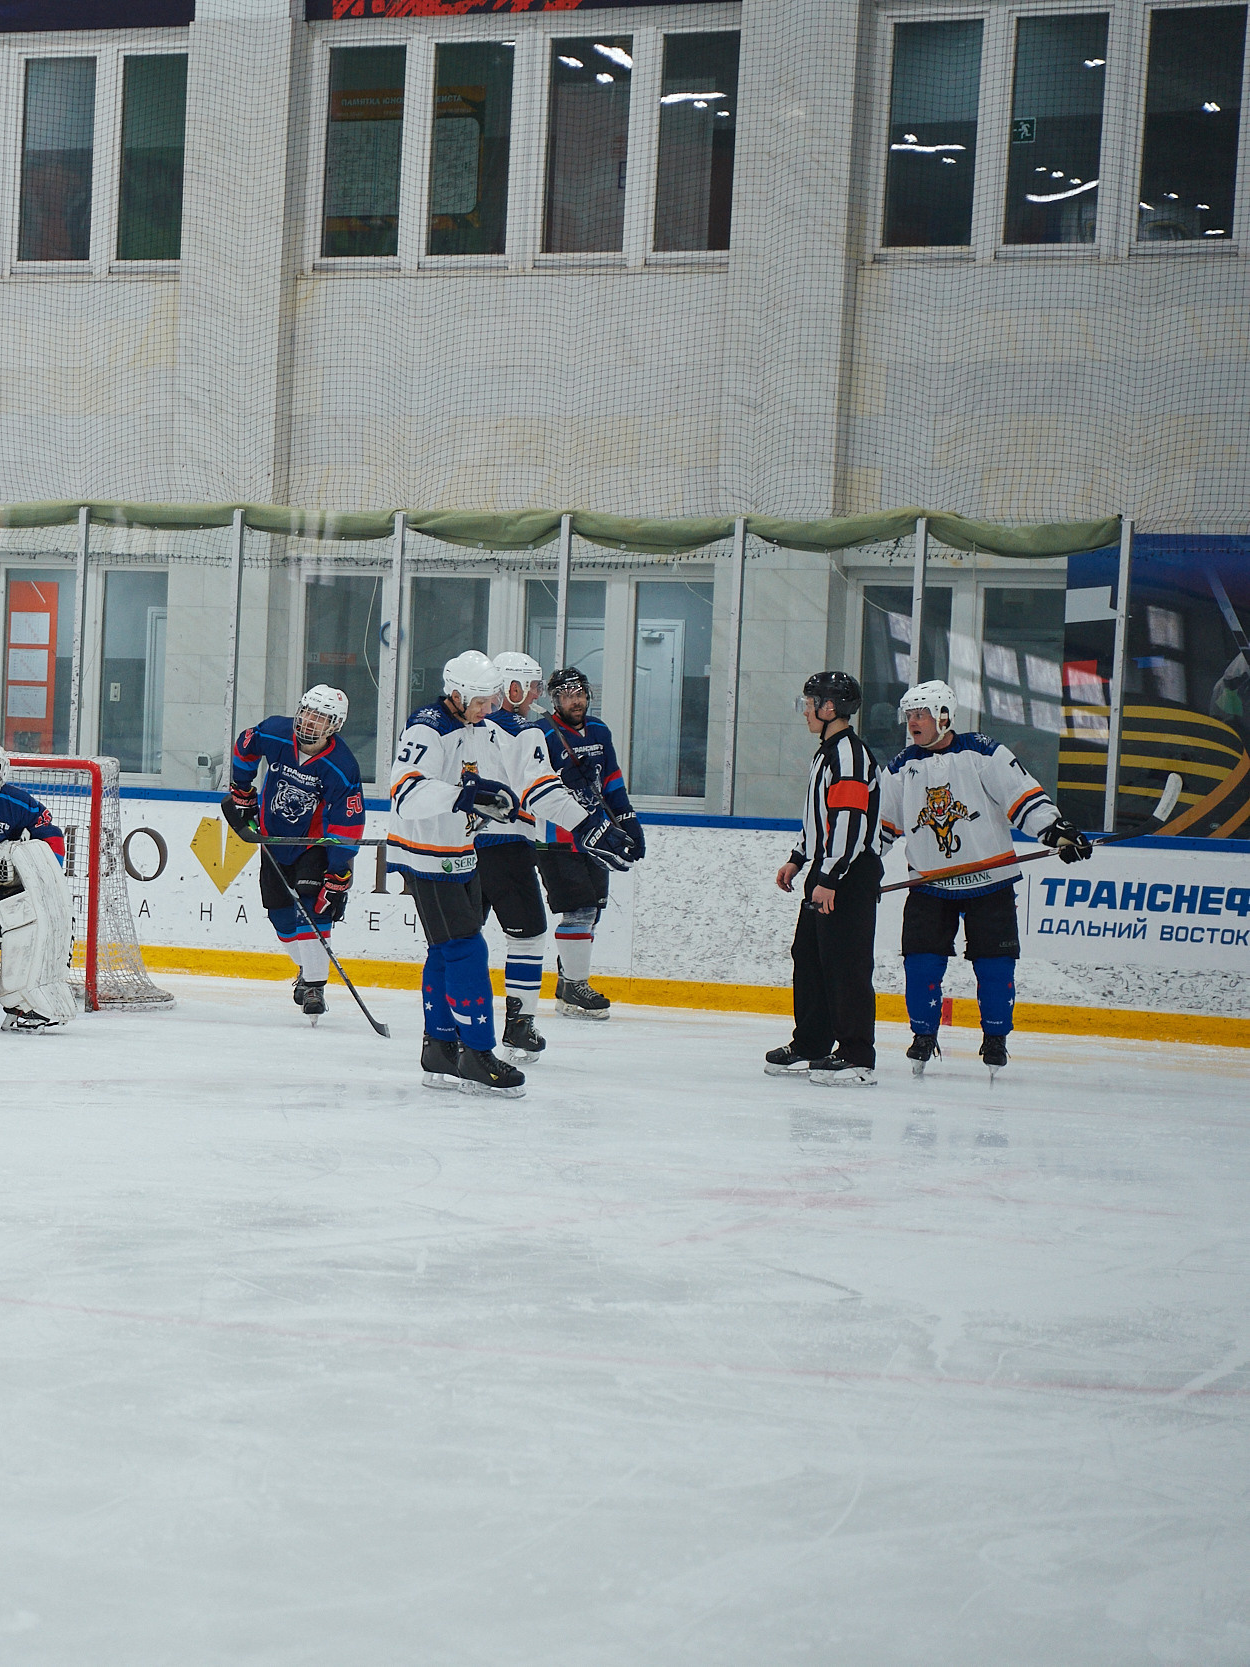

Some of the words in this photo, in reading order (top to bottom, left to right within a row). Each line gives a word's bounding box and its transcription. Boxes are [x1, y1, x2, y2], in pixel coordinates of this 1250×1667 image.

[382, 96, 404, 105] ЮНО
[533, 745, 545, 763] 4
[346, 791, 363, 817] 50
[936, 870, 993, 888] SBERBANK
[1037, 917, 1148, 940] ДАЛЬНИЙ
[1159, 924, 1250, 947] ВОСТОК
